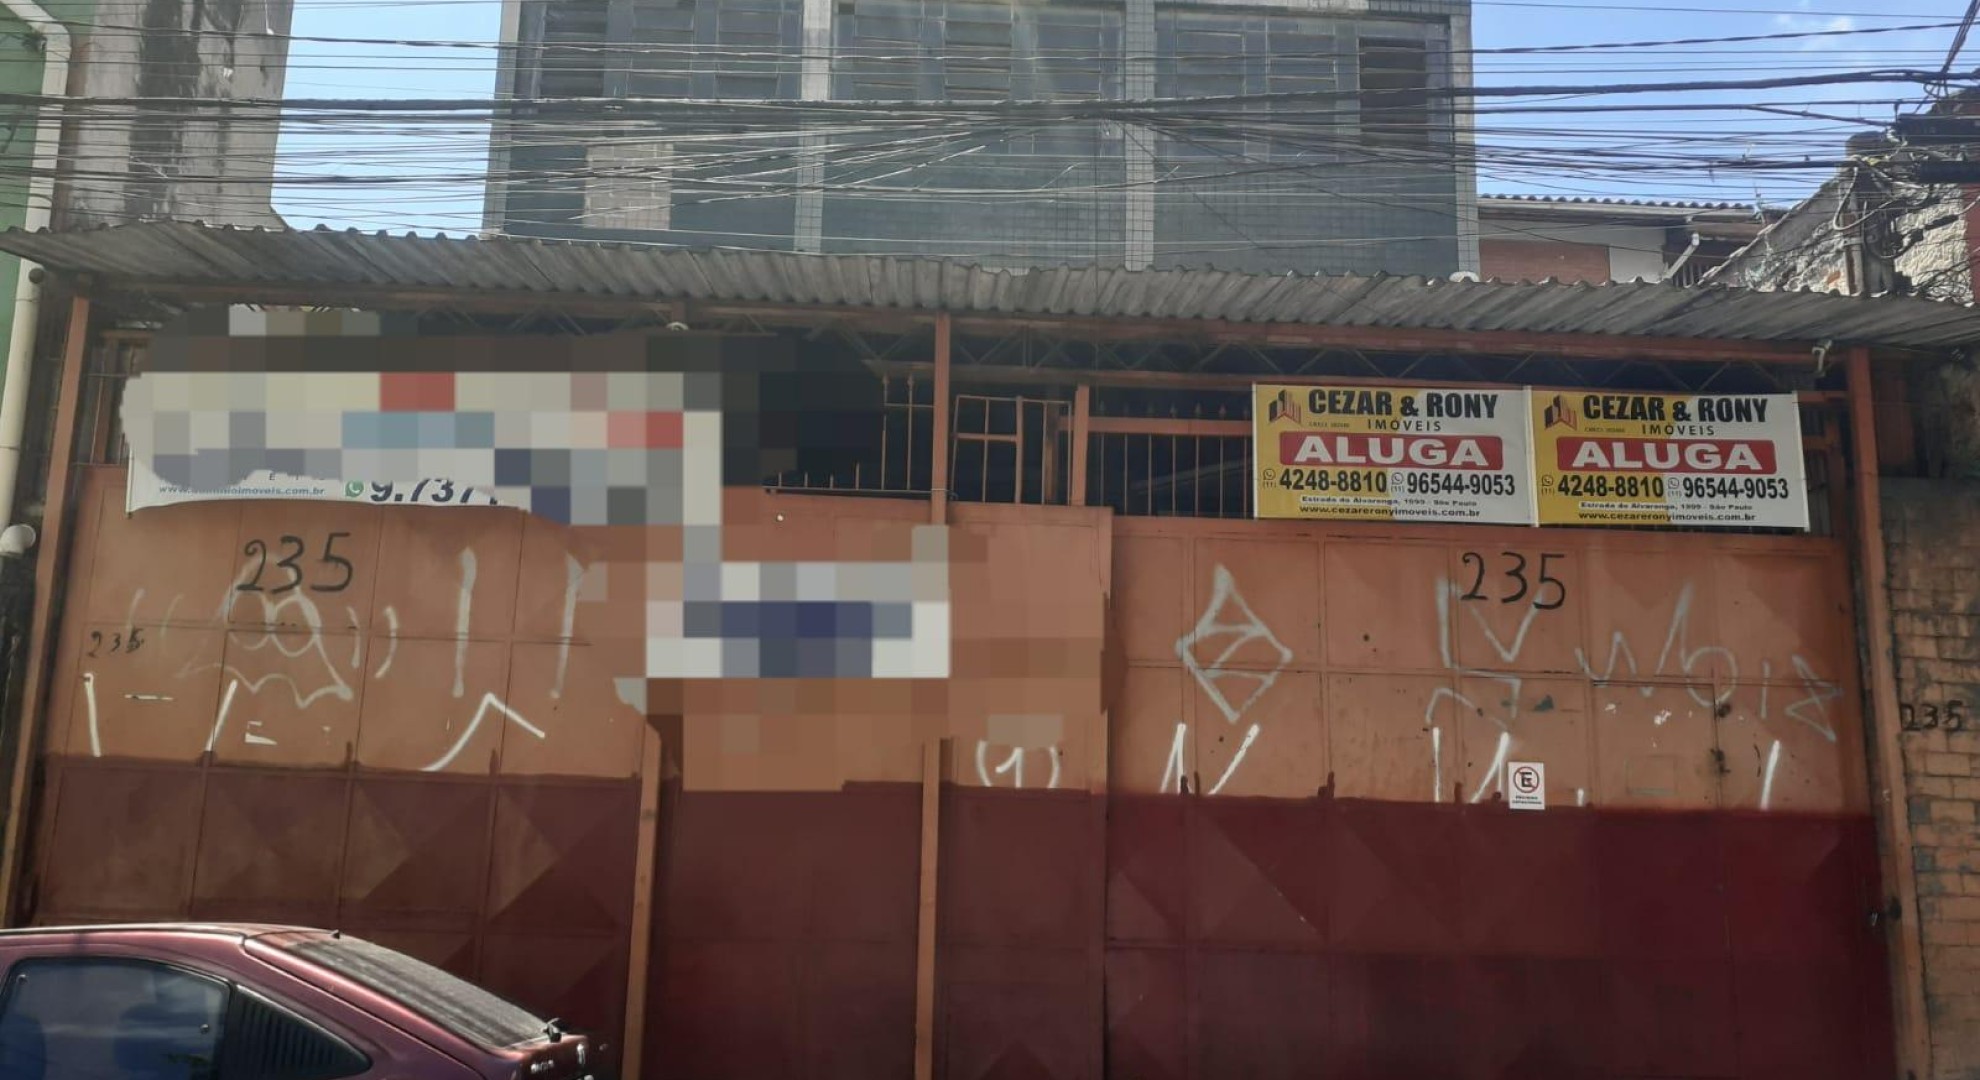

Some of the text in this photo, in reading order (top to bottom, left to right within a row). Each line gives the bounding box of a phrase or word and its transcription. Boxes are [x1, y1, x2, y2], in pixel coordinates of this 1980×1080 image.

[1308, 389, 1499, 419] CEZAR & RONY
[1583, 395, 1768, 422] CEZAR & RONY
[1367, 418, 1442, 432] IMÓVEIS
[1293, 435, 1489, 467] ALUGA
[1572, 441, 1763, 470] ALUGA
[1280, 468, 1387, 493] 4248-8810
[1407, 472, 1515, 496] 96544-9053
[1558, 475, 1664, 498] 4248-8810
[1683, 476, 1788, 499] 96544-9053
[1300, 504, 1480, 517] www.cezareronyimoveis.com.br
[1579, 511, 1756, 522] www.cezareronyimoveis.com.br
[237, 531, 354, 594] 235
[1461, 552, 1566, 610] 235
[86, 628, 145, 659] 235
